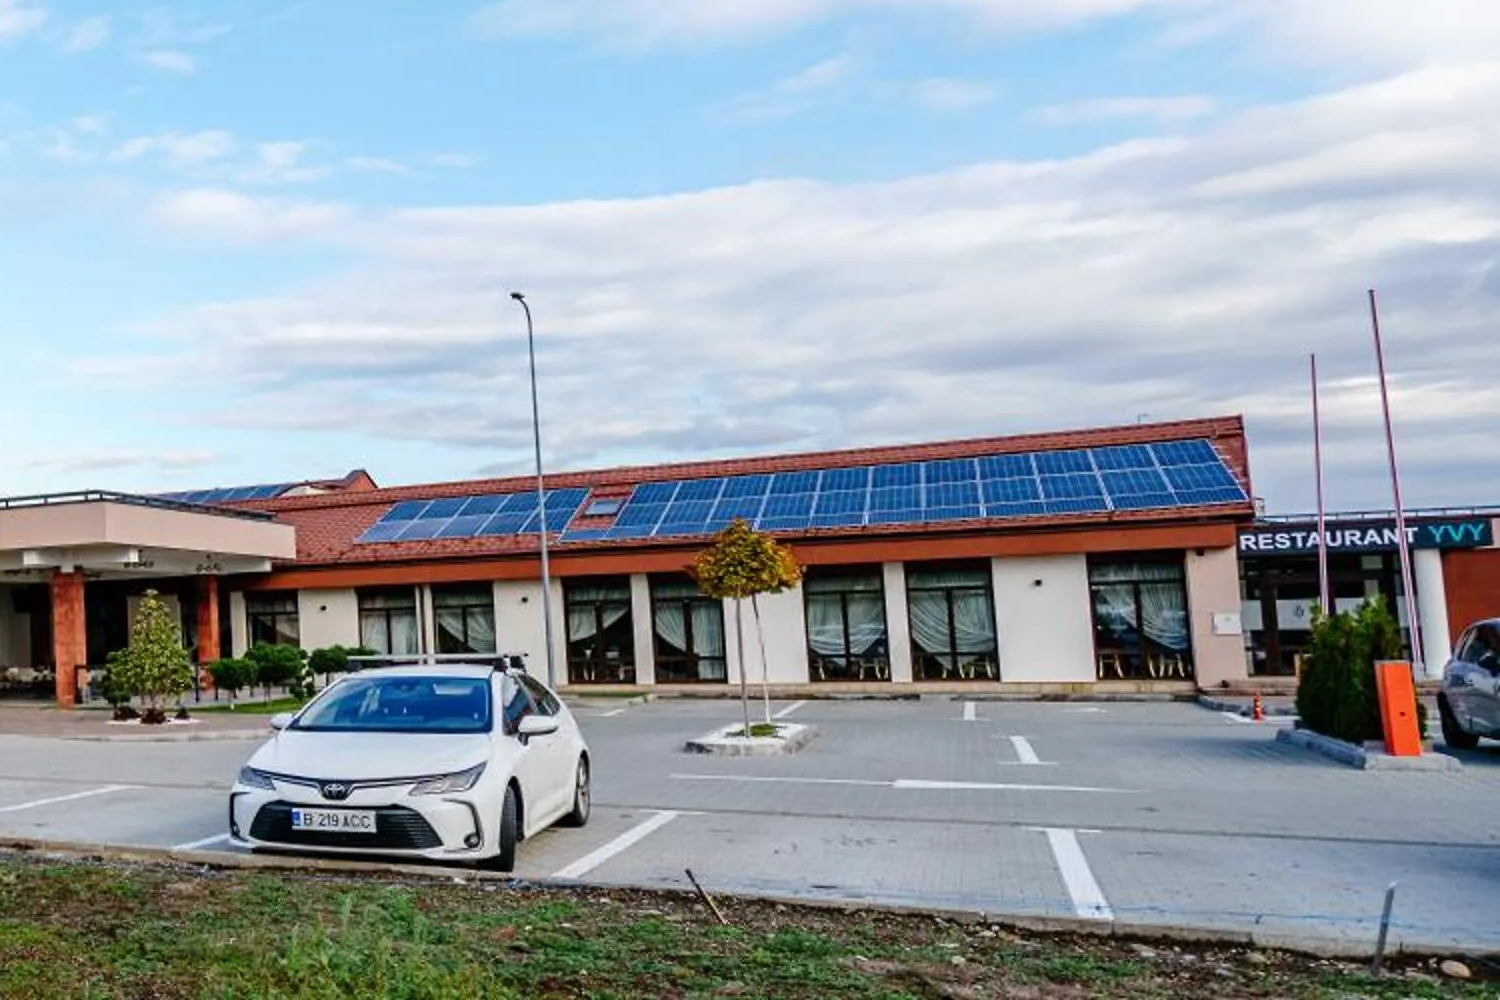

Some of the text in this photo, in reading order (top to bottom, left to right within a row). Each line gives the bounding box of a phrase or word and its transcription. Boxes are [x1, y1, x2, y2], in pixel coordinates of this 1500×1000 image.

[1239, 523, 1485, 550] RESTAURANT YVY
[318, 812, 339, 827] 219
